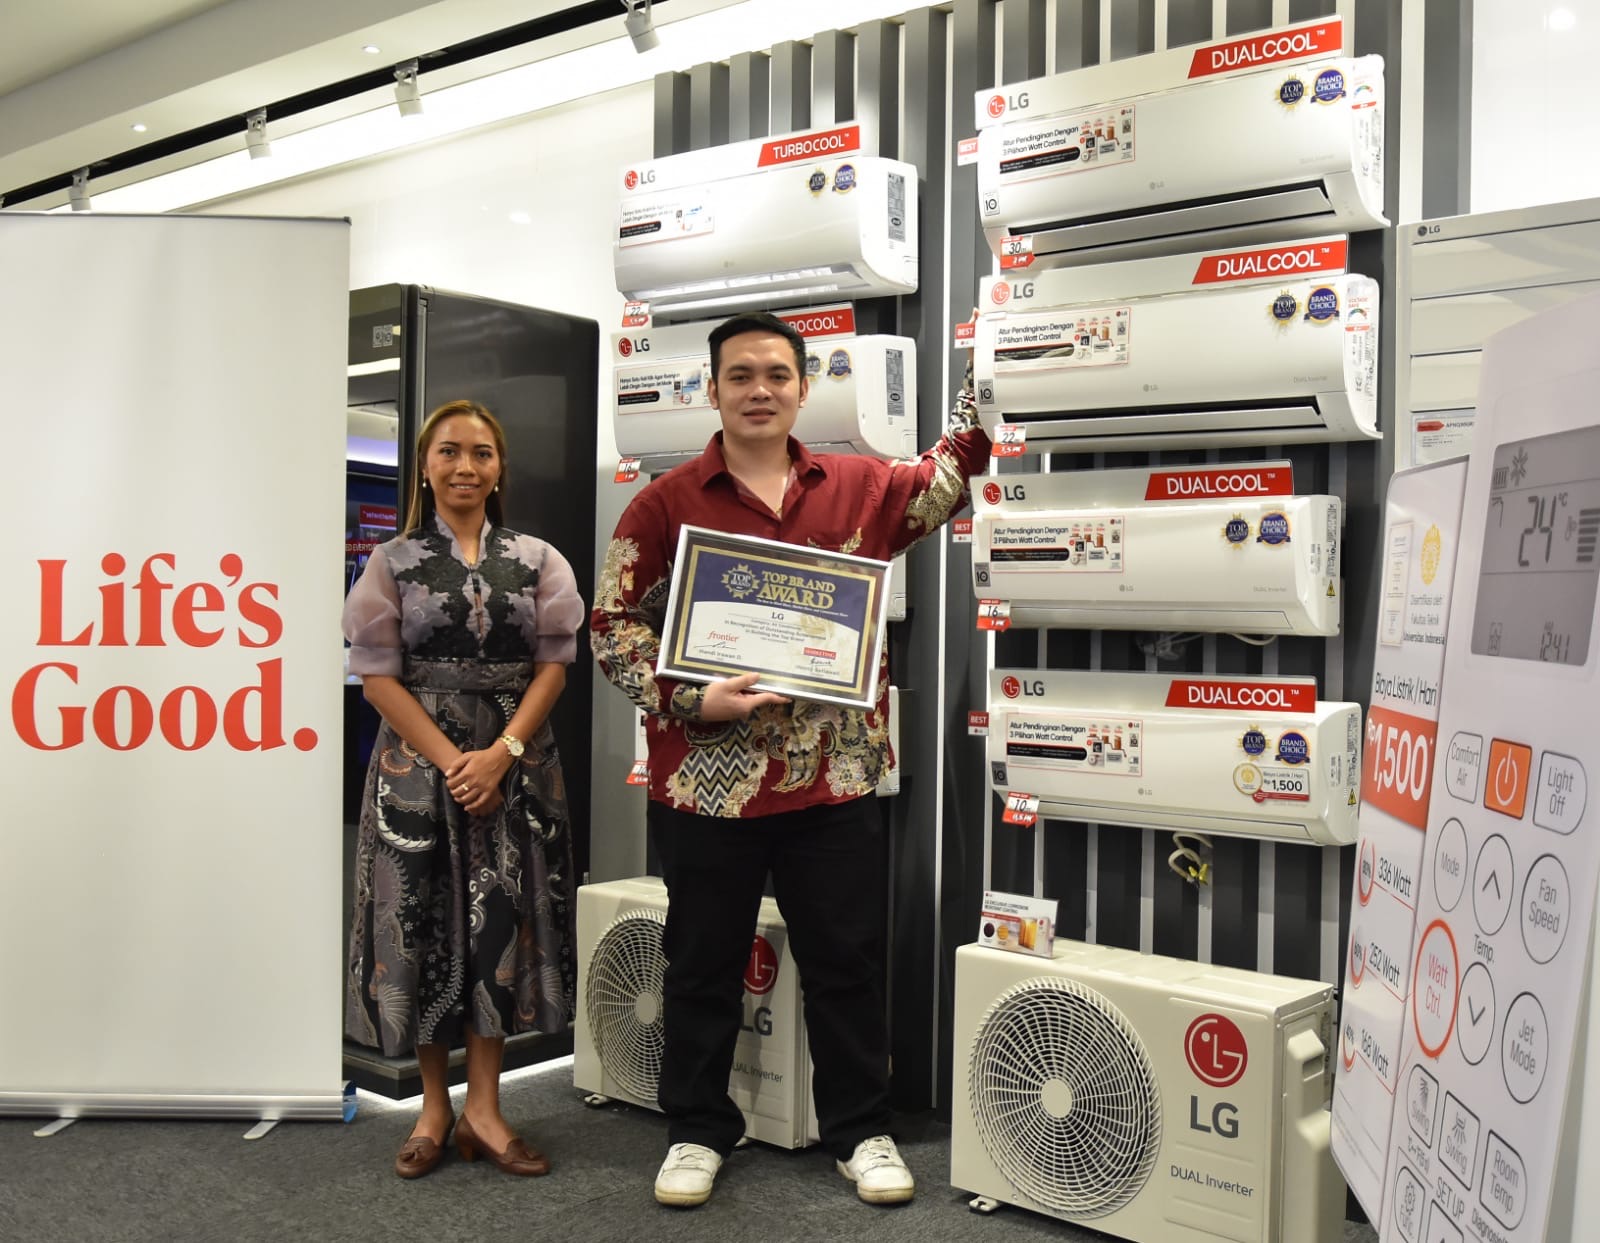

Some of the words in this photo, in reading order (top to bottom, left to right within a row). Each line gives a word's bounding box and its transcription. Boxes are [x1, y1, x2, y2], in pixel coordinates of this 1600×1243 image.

[1211, 32, 1317, 69] DUALCOOL
[1284, 83, 1301, 94] TOP
[1316, 81, 1343, 92] CHOICE
[1318, 74, 1342, 86] BRAND
[1008, 92, 1030, 111] LG
[1016, 131, 1053, 145] Pendinginan
[1054, 126, 1078, 139] Dengan
[1028, 141, 1043, 151] Watt
[1044, 137, 1066, 148] Control
[773, 134, 845, 160] TURBOCOOL
[959, 141, 977, 154] BEST
[640, 170, 655, 184] LG
[1428, 225, 1440, 234] LG
[1009, 242, 1021, 255] 30
[1216, 249, 1321, 278] DUALCOOL
[1013, 282, 1034, 300] LG
[1311, 294, 1335, 303] BRAND
[630, 306, 640, 317] 22
[1275, 300, 1294, 308] TOP
[1309, 301, 1336, 310] CHOICE
[789, 315, 839, 335] BOCOOL
[957, 327, 974, 336] BEST
[1011, 323, 1049, 336] Pendinginan
[1050, 321, 1074, 332] Dengan
[634, 338, 650, 353] LG
[1003, 335, 1023, 344] Pilihan
[1024, 334, 1038, 342] Watt
[1038, 332, 1061, 341] Control
[1002, 432, 1015, 444] 22
[1004, 485, 1025, 500] LG
[1166, 473, 1268, 495] DUALCOOL
[954, 522, 971, 531] BEST
[993, 527, 1006, 535] Atur
[1006, 526, 1043, 537] Pendinginan
[1044, 526, 1069, 536] Dengan
[1229, 523, 1246, 532] TOP
[1261, 526, 1287, 535] CHOICE
[1263, 519, 1286, 528] BRAND
[1518, 495, 1557, 568] 24
[998, 536, 1018, 545] Pilihan
[1018, 536, 1033, 544] Watt
[1033, 536, 1056, 544] Control
[732, 573, 751, 583] TOP
[762, 570, 788, 585] TOP
[788, 575, 836, 593] BRAND
[36, 552, 283, 648] Life's
[756, 582, 834, 610] AWARD
[771, 611, 785, 620] LG
[988, 605, 998, 617] 16
[706, 630, 739, 643] frontier
[1023, 680, 1045, 697] LG
[1187, 685, 1291, 708] DUALCOOL
[1375, 672, 1392, 698] Biaya
[1392, 675, 1414, 701] Listrik
[1420, 680, 1438, 706] Hari
[12, 656, 318, 752] Good.
[970, 716, 987, 724] BEST
[1009, 721, 1022, 730] Atur
[1022, 721, 1060, 733] Pendinginan
[1061, 724, 1086, 734] Dengan
[1014, 731, 1035, 741] Pilihan
[1035, 732, 1050, 741] Watt
[1050, 732, 1073, 742] Control
[1245, 735, 1264, 744] TOP
[1281, 738, 1306, 747] BRAND
[1279, 745, 1306, 754] CHOICE
[1451, 741, 1480, 767] Comfort
[1374, 722, 1428, 802] 1,500
[1457, 766, 1468, 786] Air
[1547, 766, 1574, 794] Light
[1271, 779, 1303, 792] 1,500
[1014, 799, 1027, 812] 10
[1549, 795, 1566, 817] Off
[1441, 852, 1460, 877] Mode
[1378, 857, 1393, 885] 336
[1393, 865, 1412, 898] Watt
[1538, 878, 1557, 905] Fan
[1528, 901, 1560, 934] Speed
[1473, 934, 1495, 964] Temp.
[1369, 943, 1383, 972] 252
[1382, 950, 1401, 989] Watt
[1428, 952, 1448, 990] Watt
[1425, 985, 1442, 1019] Ctrl.
[741, 1006, 773, 1036] LG
[1518, 1019, 1535, 1046] Jet
[1361, 1028, 1373, 1057] 168
[1372, 1043, 1389, 1079] Watt
[1509, 1039, 1537, 1076] Mode
[750, 1065, 783, 1083] Inverter
[1189, 1094, 1239, 1139] LG
[1445, 1135, 1468, 1176] Swing
[1494, 1149, 1520, 1188] Room
[1170, 1163, 1204, 1184] DUAL
[1205, 1172, 1254, 1198] Inverter
[1436, 1176, 1453, 1208] SET
[1453, 1193, 1465, 1219] UP
